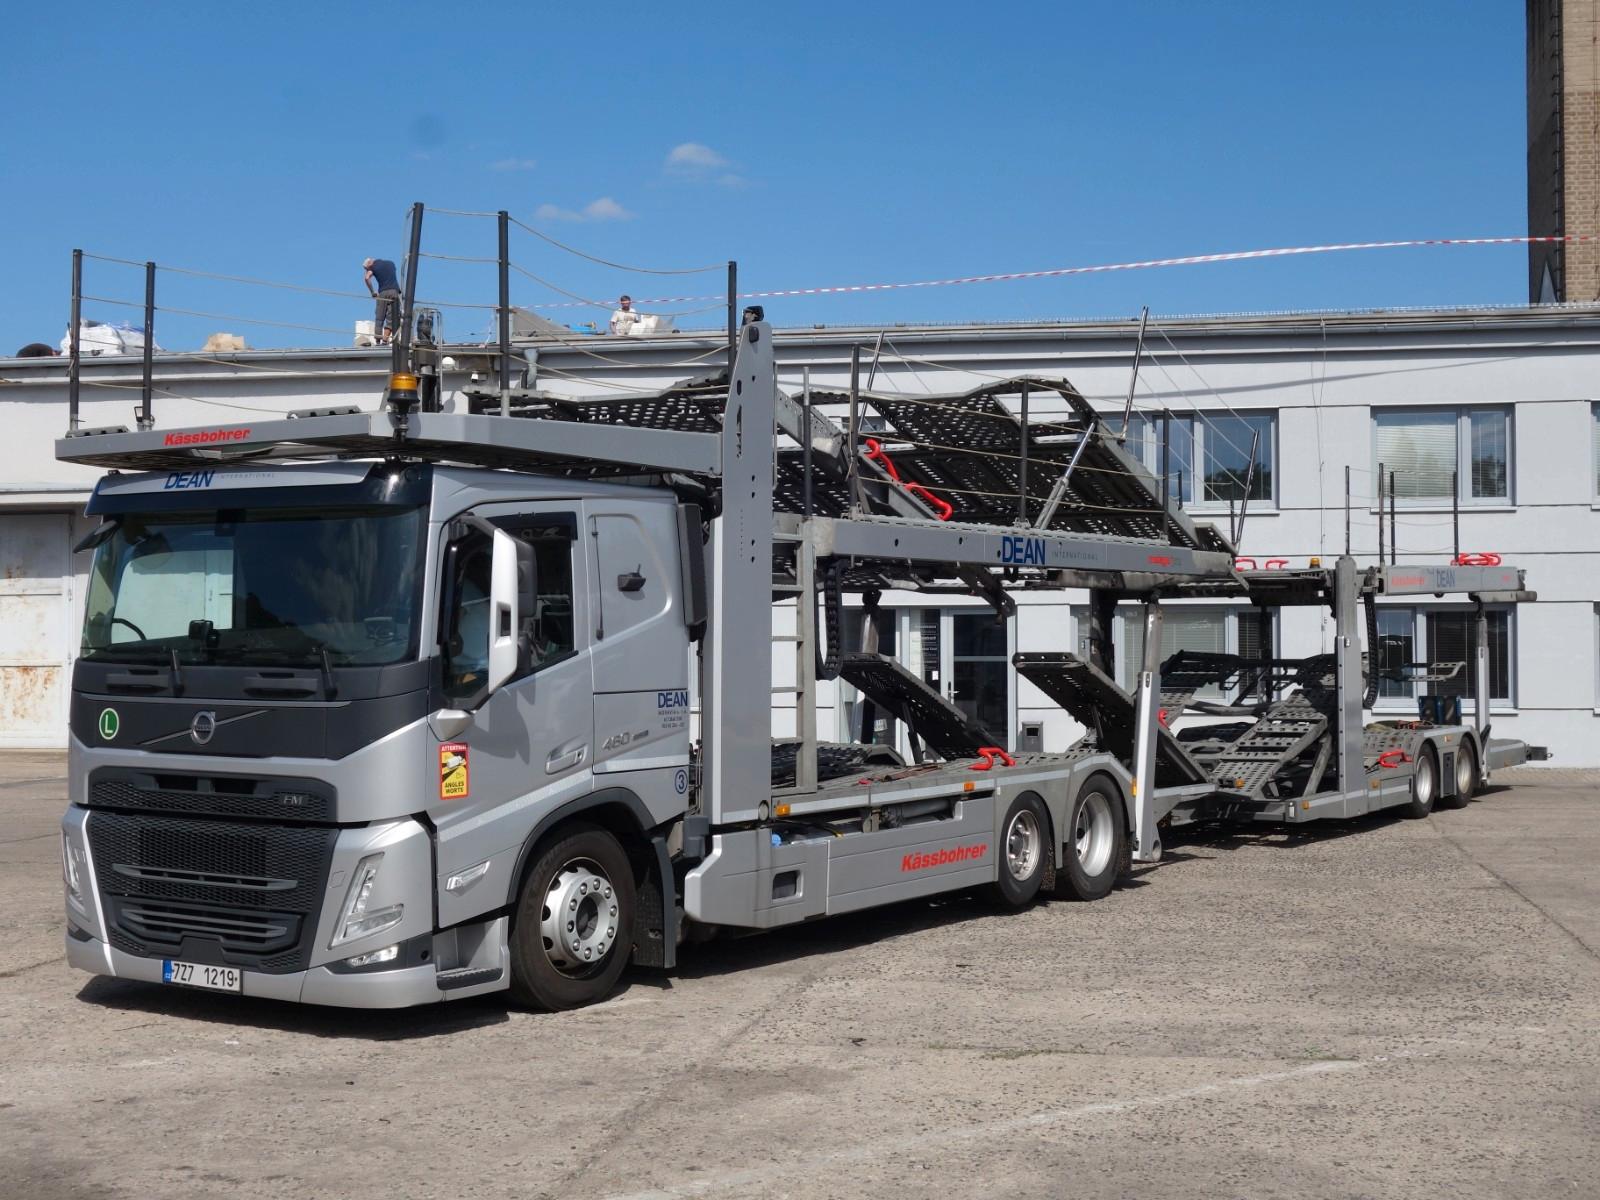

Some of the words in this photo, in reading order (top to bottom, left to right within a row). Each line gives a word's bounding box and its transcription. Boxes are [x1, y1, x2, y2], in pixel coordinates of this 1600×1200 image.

[164, 428, 251, 446] Kässbohrer
[164, 470, 215, 490] DEAN
[1002, 536, 1046, 565] DEAN
[657, 691, 688, 709] DEAN
[104, 714, 114, 734] L
[602, 732, 630, 751] 460
[445, 781, 464, 789] ANGLES
[678, 774, 685, 790] 3
[283, 795, 304, 805] FM
[902, 843, 987, 872] Kässbohrer
[173, 962, 194, 982] 7Z7
[204, 967, 234, 987] 1219
